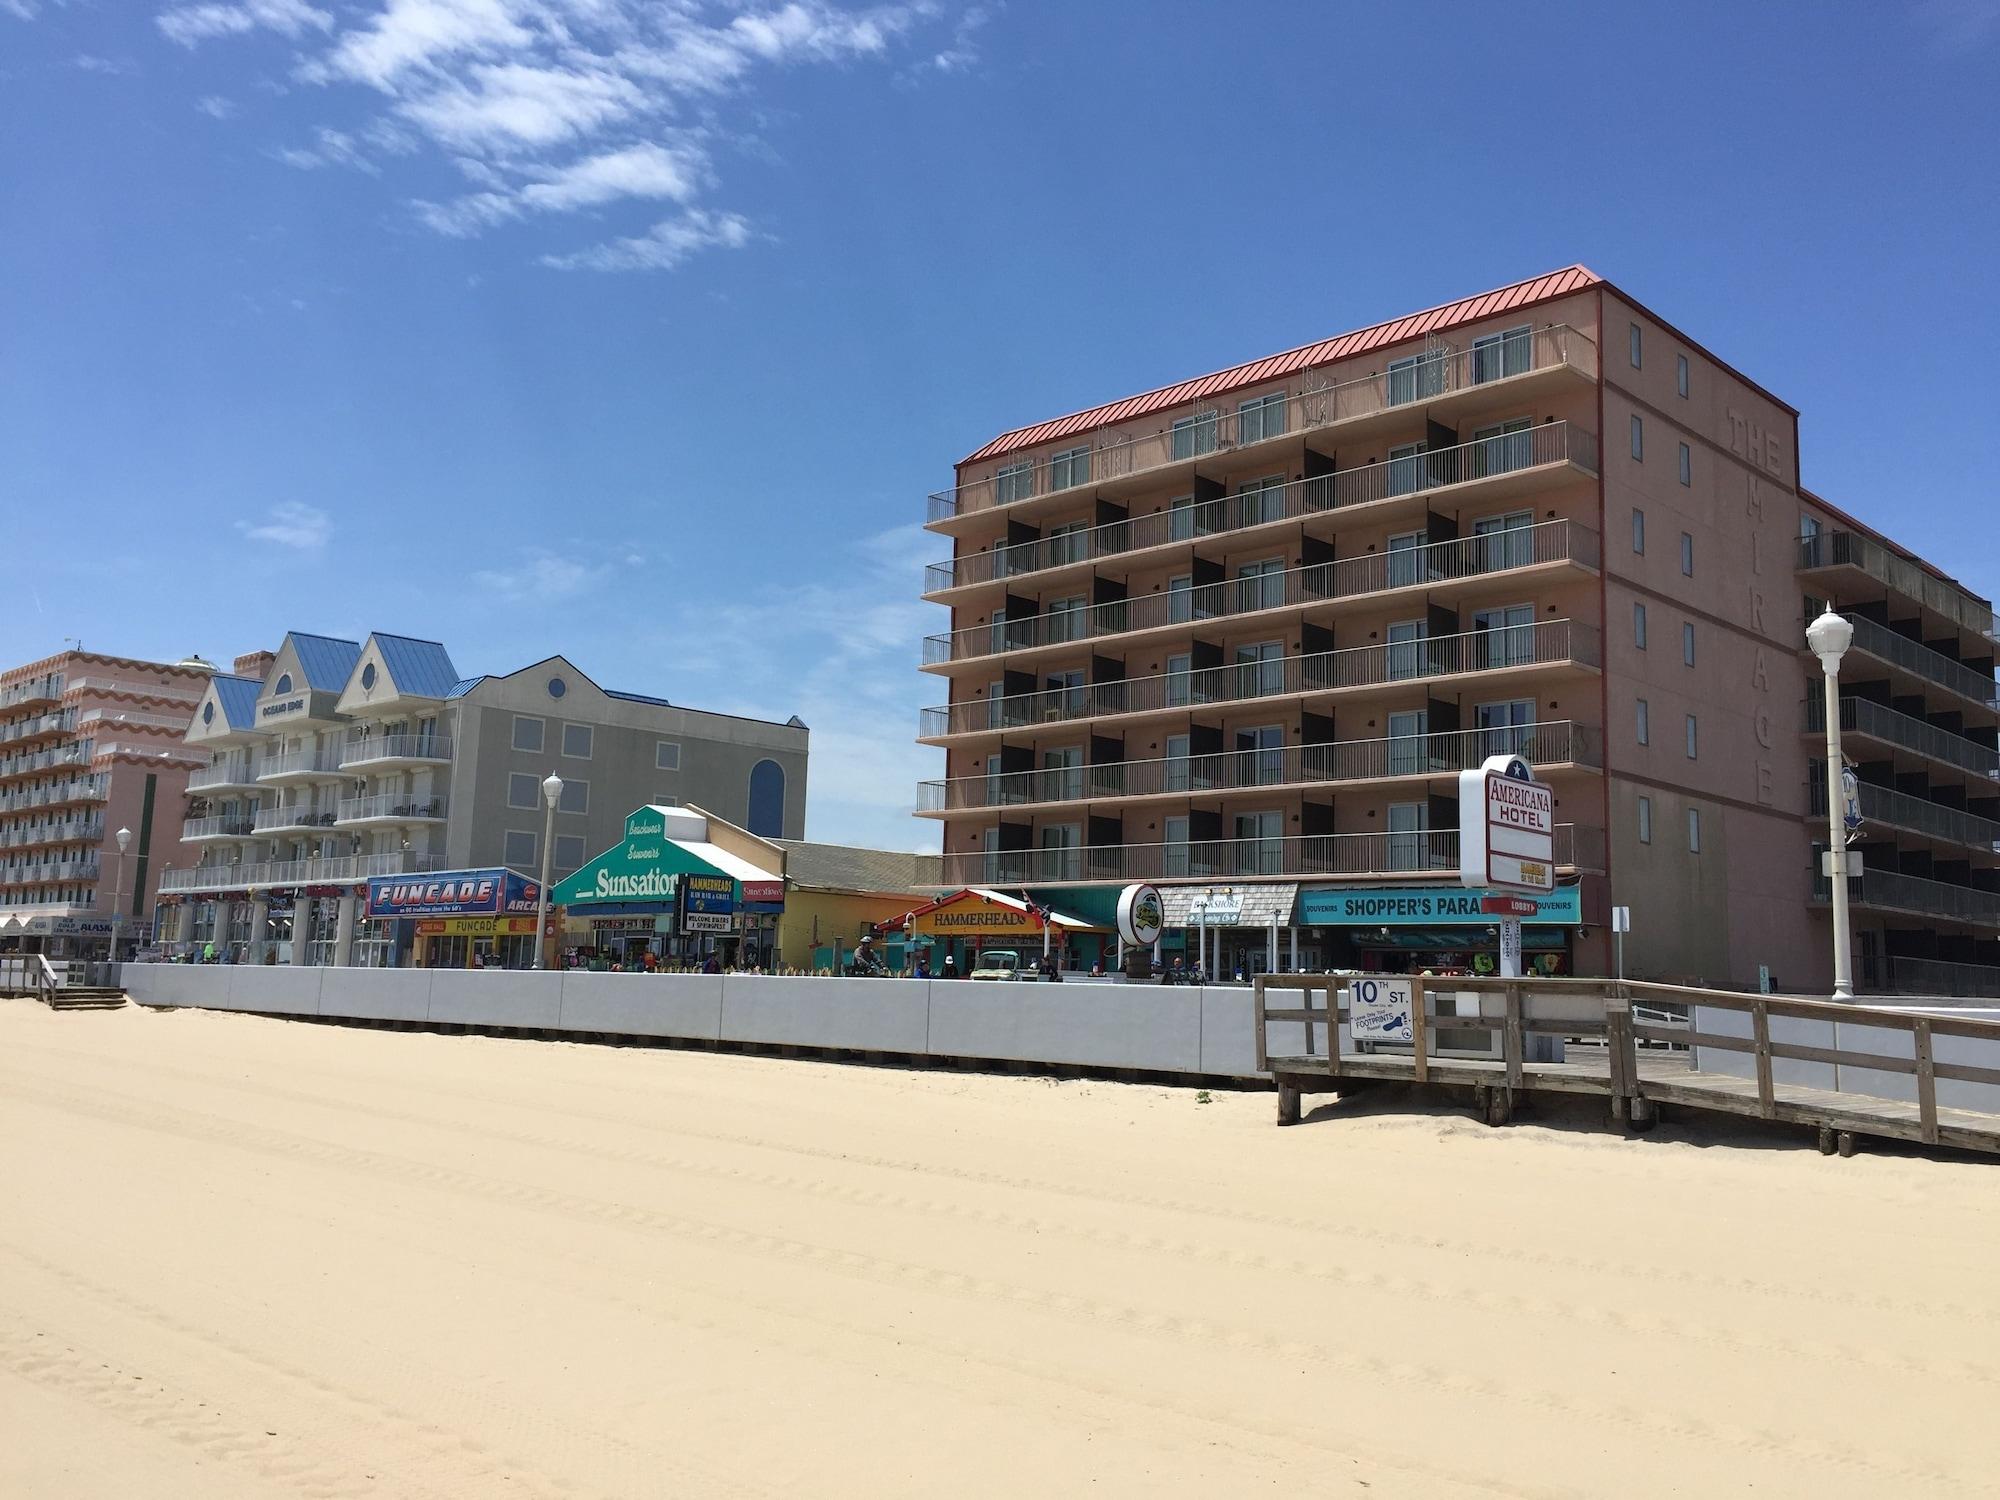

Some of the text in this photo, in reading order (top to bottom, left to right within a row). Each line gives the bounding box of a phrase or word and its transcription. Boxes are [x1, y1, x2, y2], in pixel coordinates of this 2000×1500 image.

[1726, 405, 1782, 480] THE
[1746, 473, 1773, 808] MIRAGE
[1490, 779, 1550, 812] AMERICANA
[1500, 805, 1544, 828] HOTEL
[596, 867, 679, 898] Sunsation
[689, 877, 732, 892] HAMMERHEADS
[375, 880, 493, 907] FUNCADE
[507, 900, 554, 911] ARCAE
[1306, 904, 1338, 913] SOUVENIRS
[1345, 897, 1431, 916] SHOPPER'S
[1536, 902, 1572, 911] OUVENIRS
[1511, 900, 1530, 911] LOBBY
[456, 920, 497, 931] FUNCADE
[688, 915, 711, 923] WELCOME
[934, 912, 1026, 927] HAMMERHEADS
[1389, 991, 1409, 1003] ST.
[1355, 1012, 1394, 1029] FOOTPRINTS
